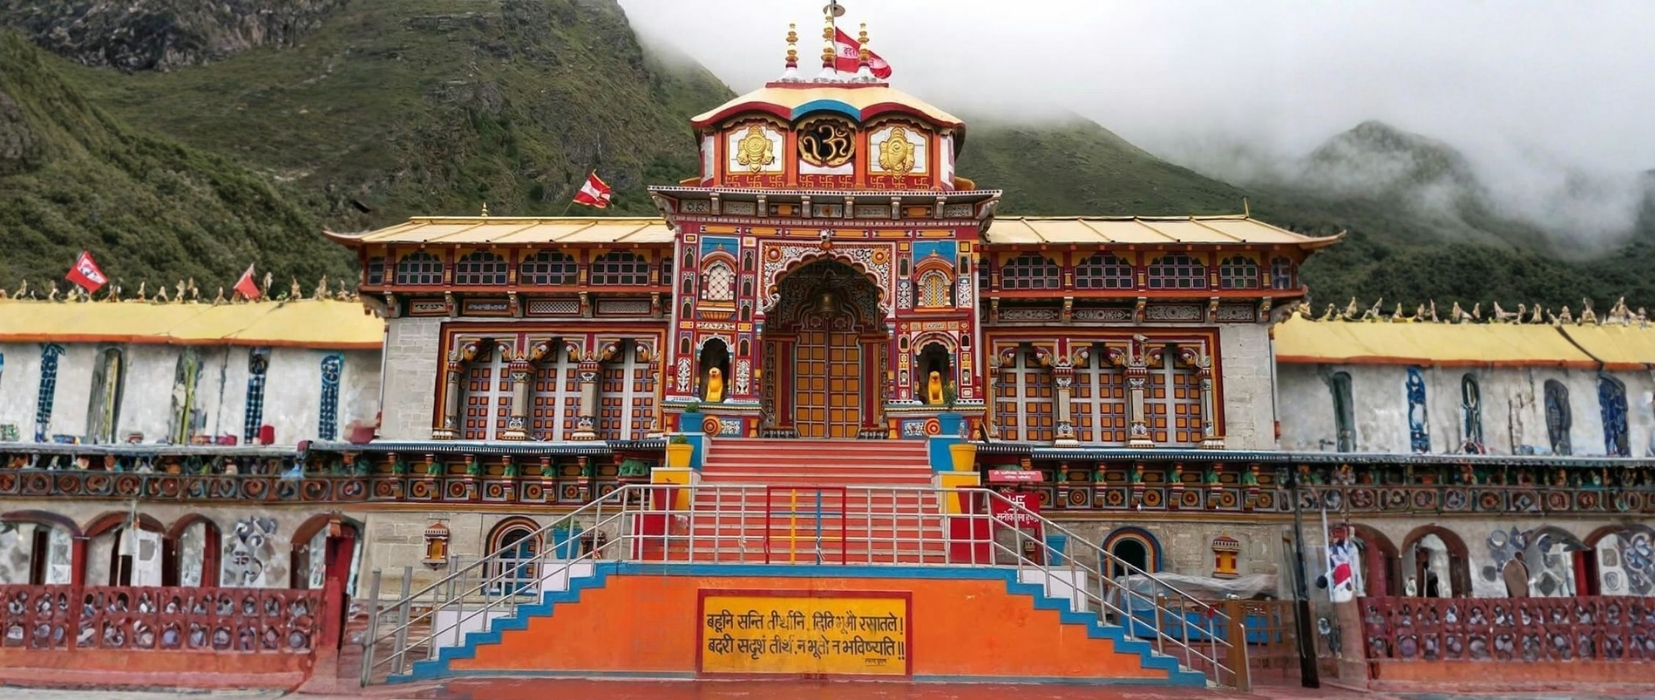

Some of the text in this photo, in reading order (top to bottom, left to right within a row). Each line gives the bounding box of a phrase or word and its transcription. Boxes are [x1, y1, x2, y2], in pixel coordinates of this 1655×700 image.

[707, 609, 735, 634] बहूनि
[738, 609, 765, 631] सन्ति
[708, 633, 735, 655] बदरी
[737, 635, 766, 660] सदृशं
[797, 640, 806, 654] न
[831, 640, 841, 655] न
